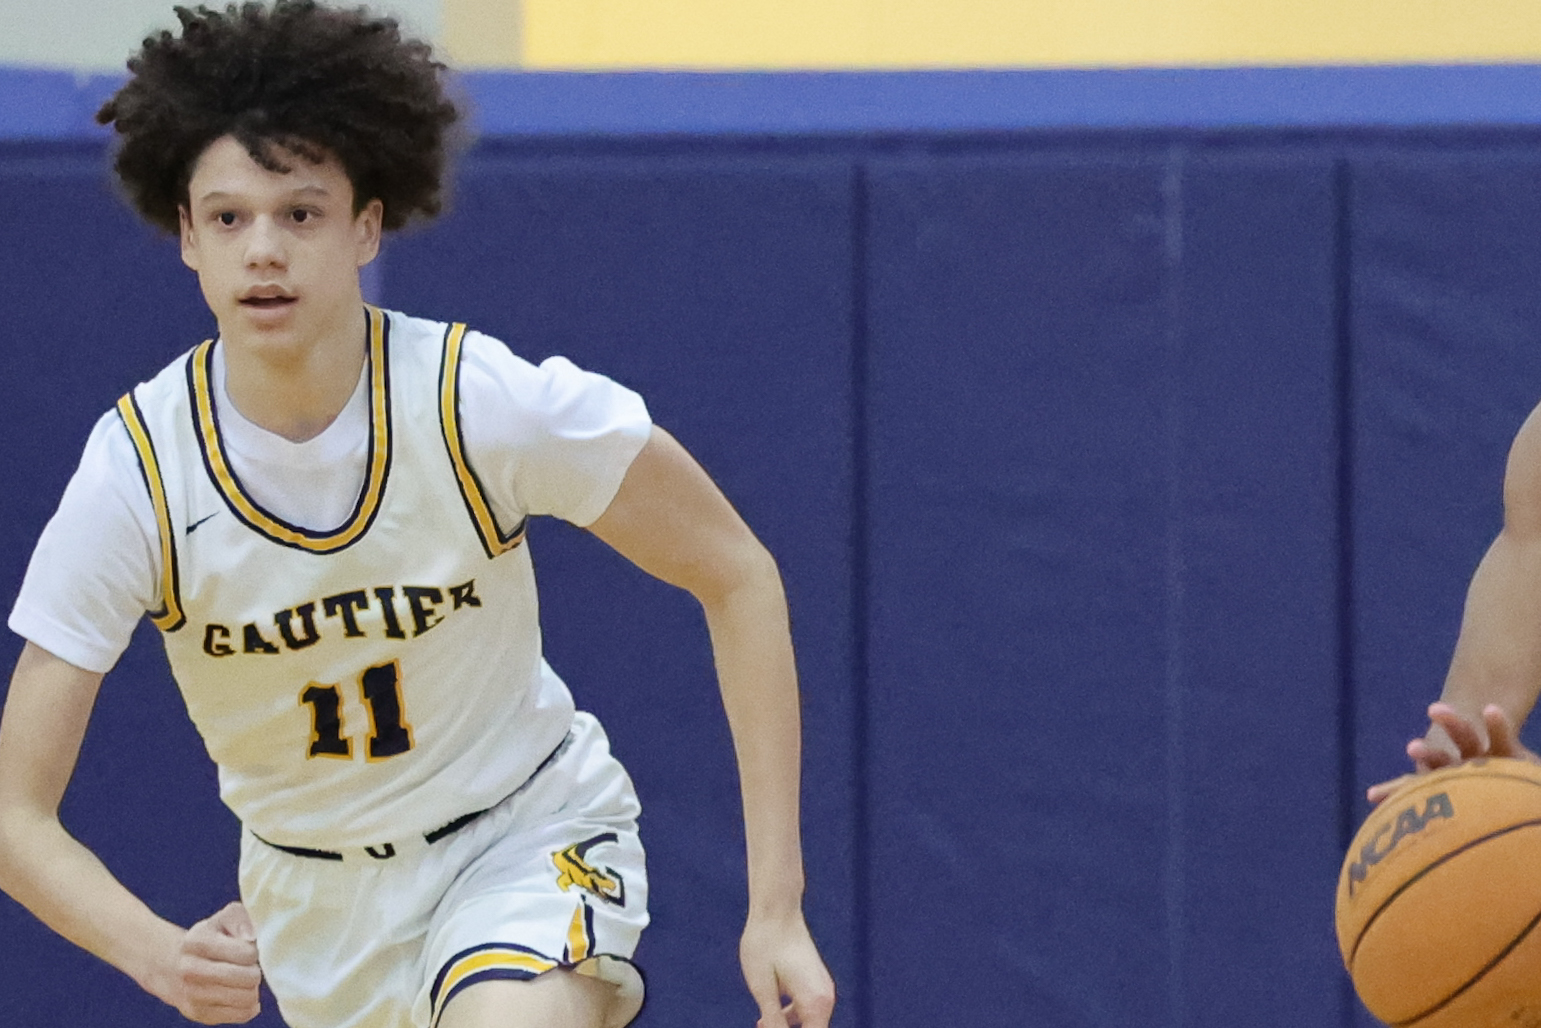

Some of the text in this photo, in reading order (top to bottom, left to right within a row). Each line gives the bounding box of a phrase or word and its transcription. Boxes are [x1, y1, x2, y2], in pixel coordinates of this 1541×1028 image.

[203, 579, 482, 657] GAUTIER
[298, 658, 415, 763] 11
[1347, 792, 1454, 898] NCAA
